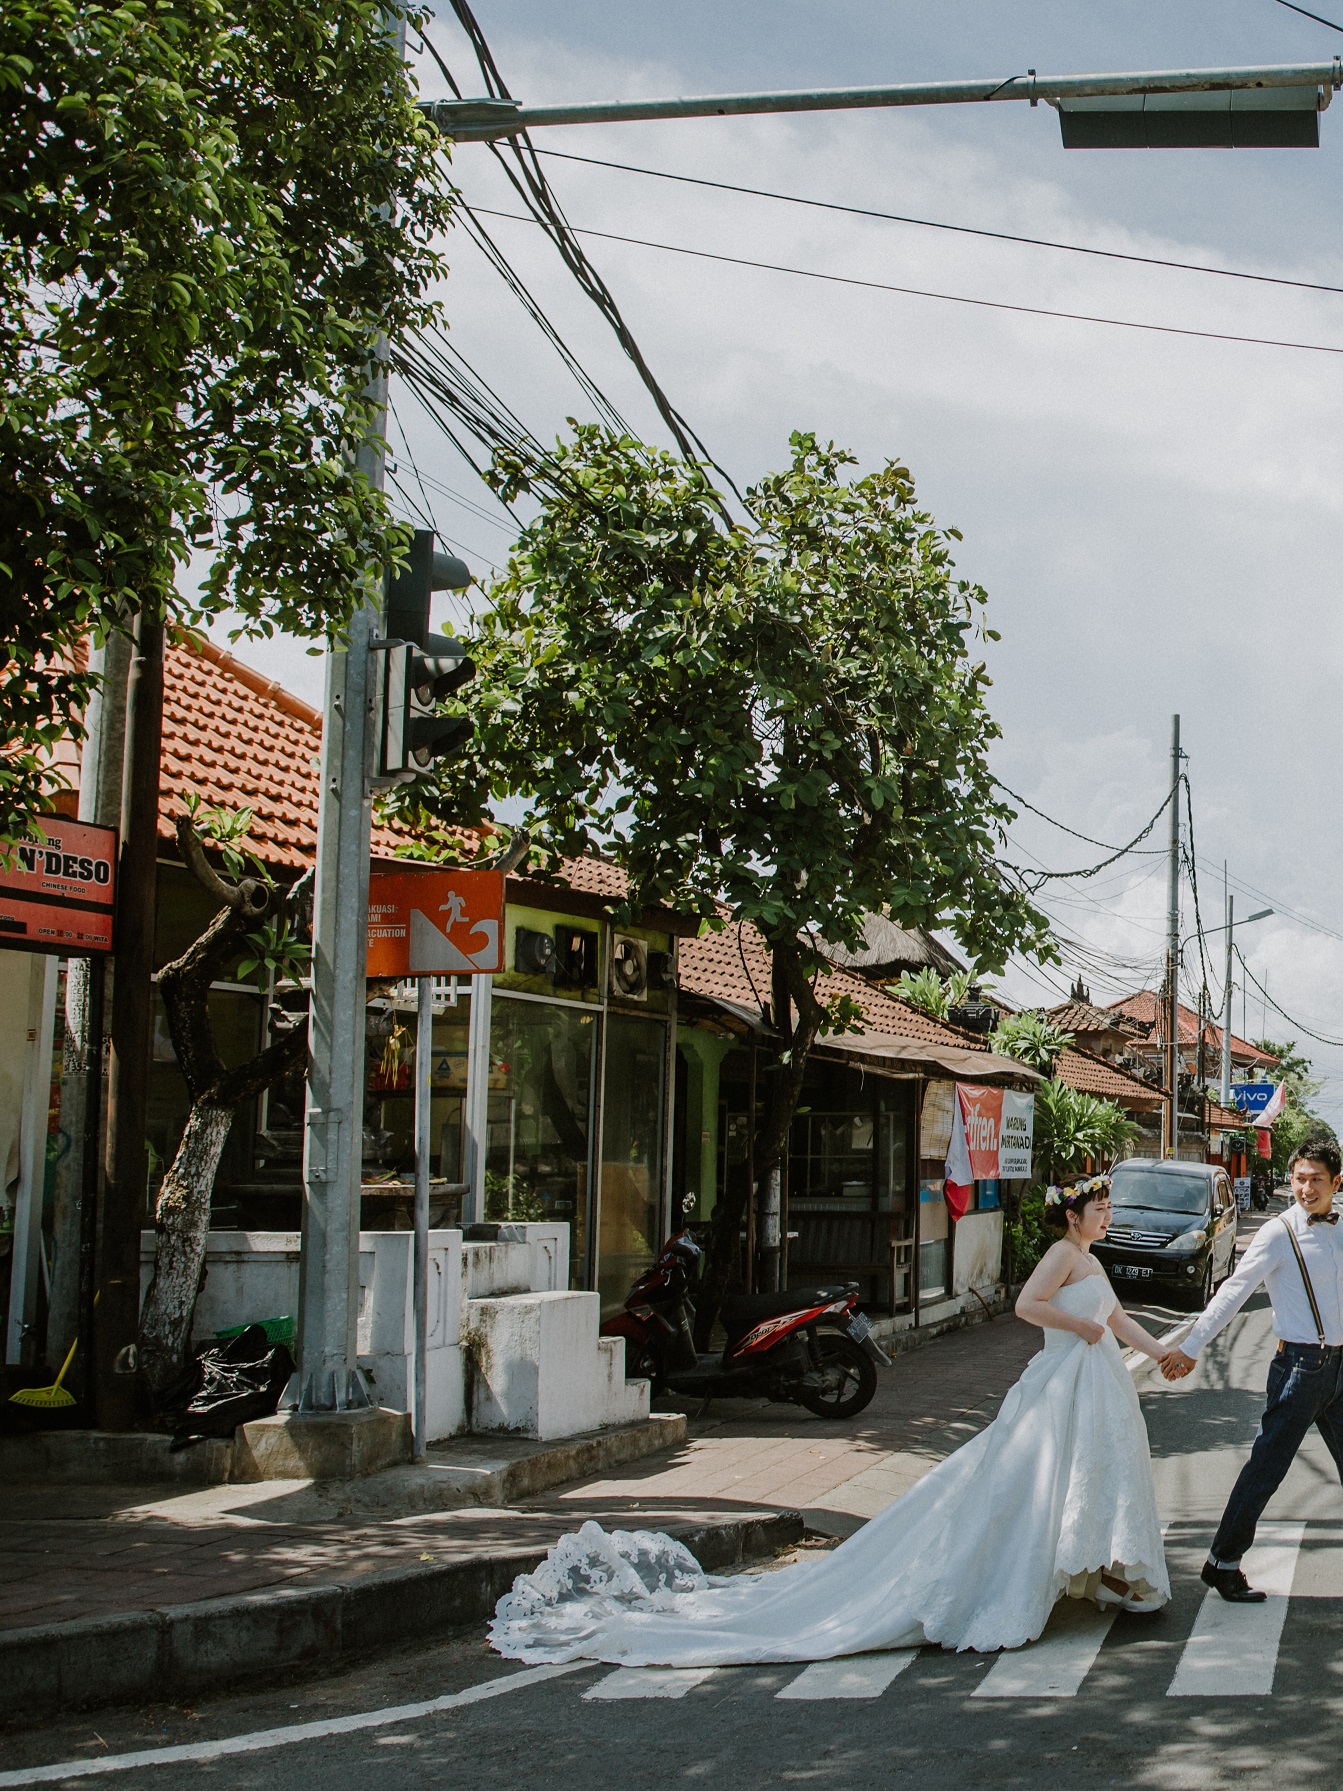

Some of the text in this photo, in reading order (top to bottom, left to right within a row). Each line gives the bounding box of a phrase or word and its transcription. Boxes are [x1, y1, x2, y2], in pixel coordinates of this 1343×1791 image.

[41, 881, 86, 894] CHINESE FOOD
[38, 928, 55, 936] OPEN
[1234, 1090, 1268, 1101] vivo
